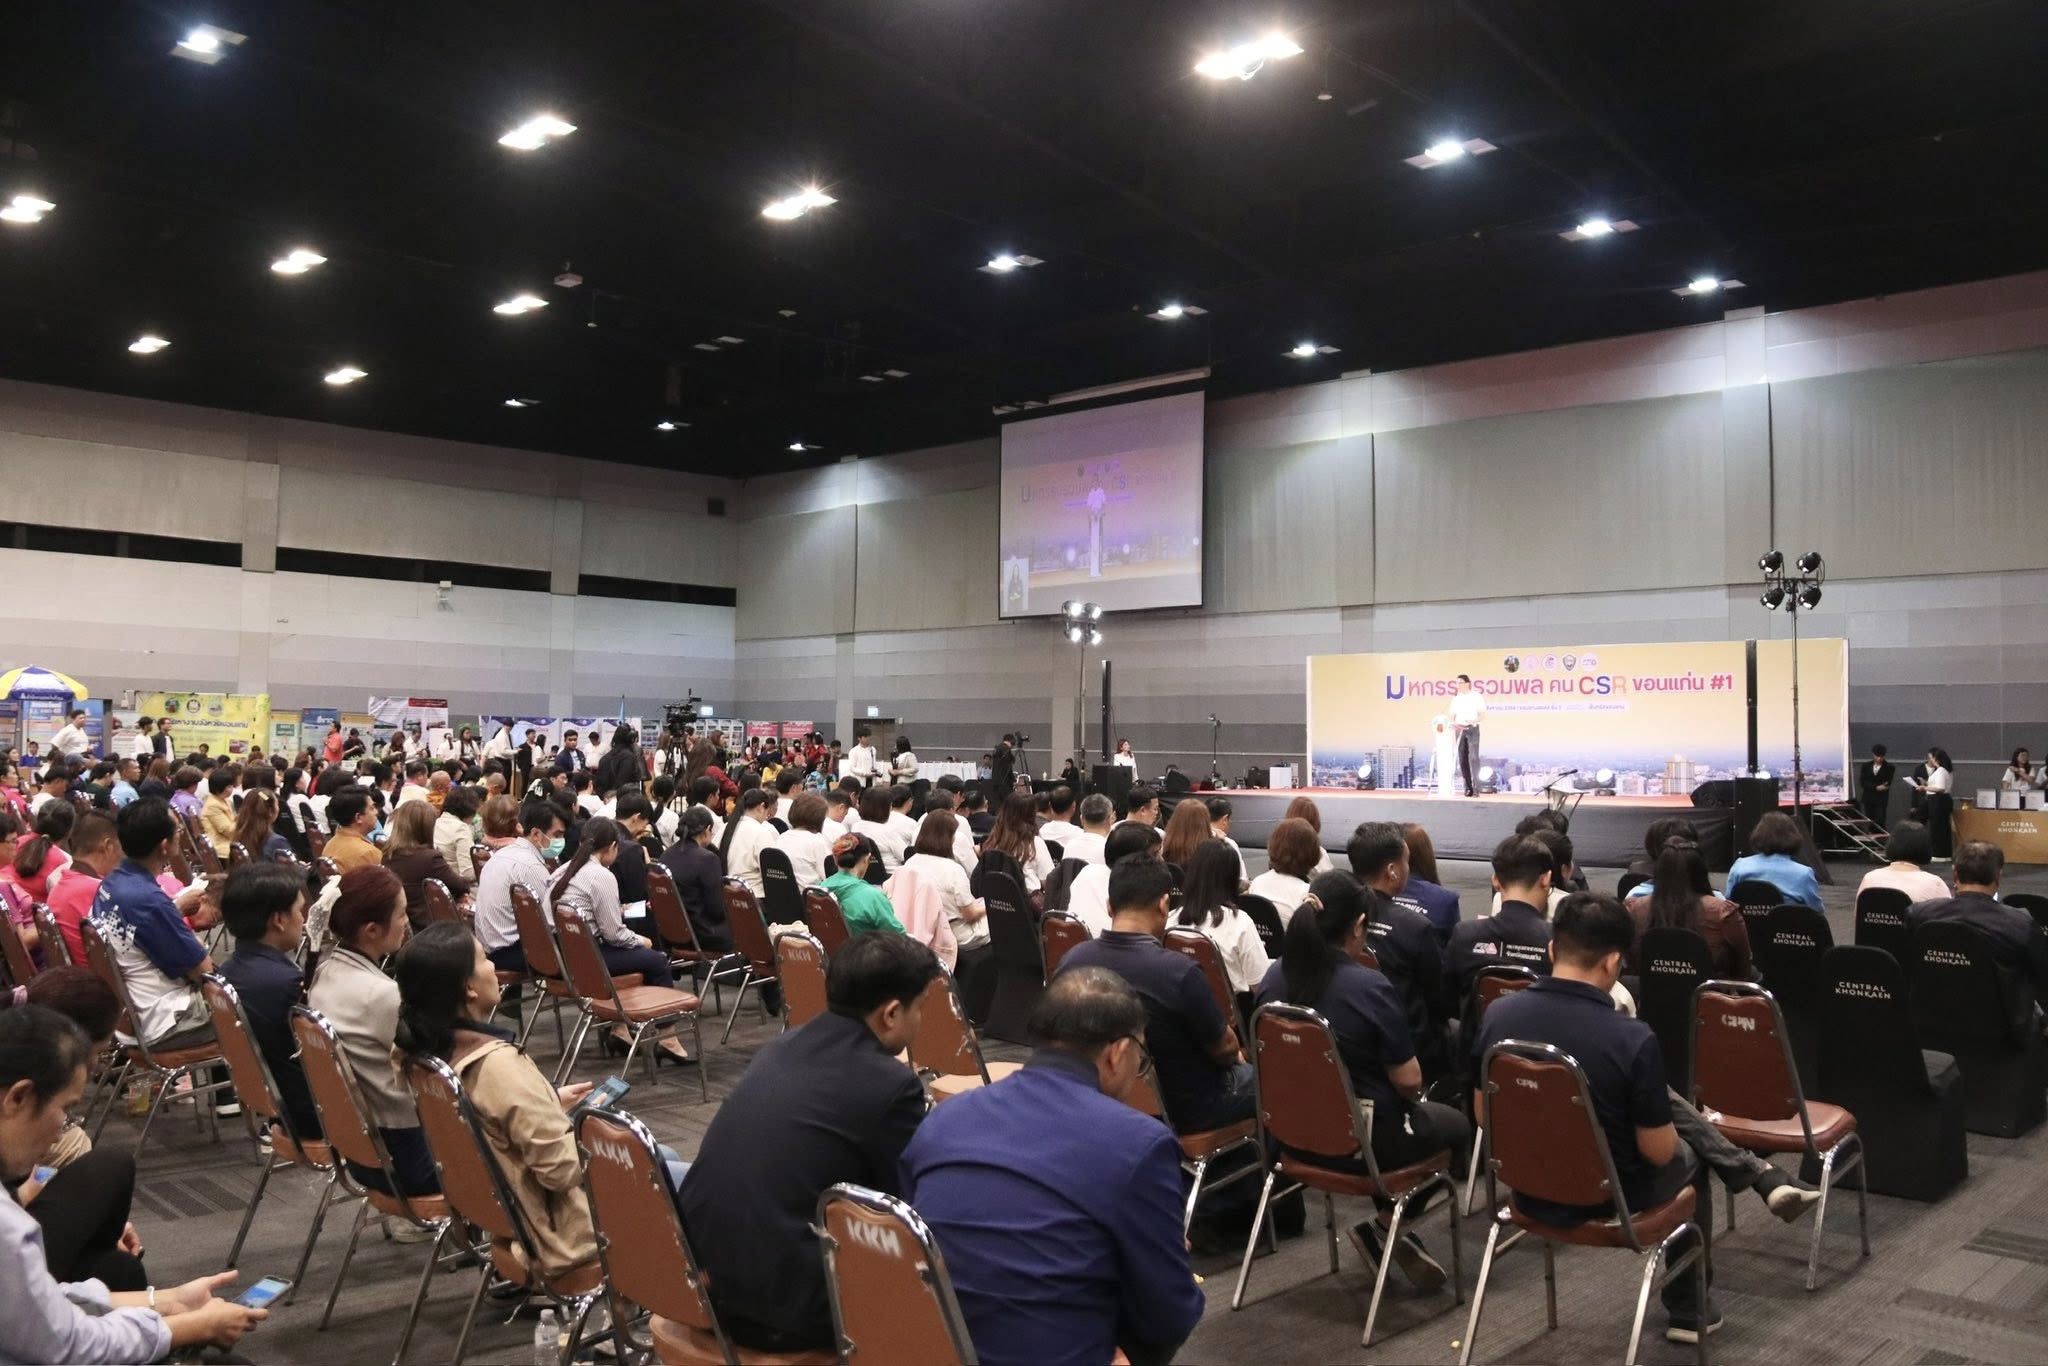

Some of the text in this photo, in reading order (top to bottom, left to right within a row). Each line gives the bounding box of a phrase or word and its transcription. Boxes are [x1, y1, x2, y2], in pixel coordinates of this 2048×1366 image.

[1386, 671, 1733, 699] มหกรรรวมพล คน CSR ขอนแก่น #1
[1865, 912, 1899, 921] CENTRAL
[1864, 918, 1903, 926] KHONKAEN
[1775, 932, 1811, 941] CENTRAL
[1773, 938, 1816, 947] KHONKAEN
[1927, 949, 1966, 960] CENTRAL
[1653, 959, 1693, 969] CENTRAL
[1923, 955, 1971, 966] KHONKAEN
[1650, 965, 1697, 975] KHONKAEN
[1838, 981, 1887, 992] CENTRAL
[1835, 987, 1891, 999] KHONKAEN
